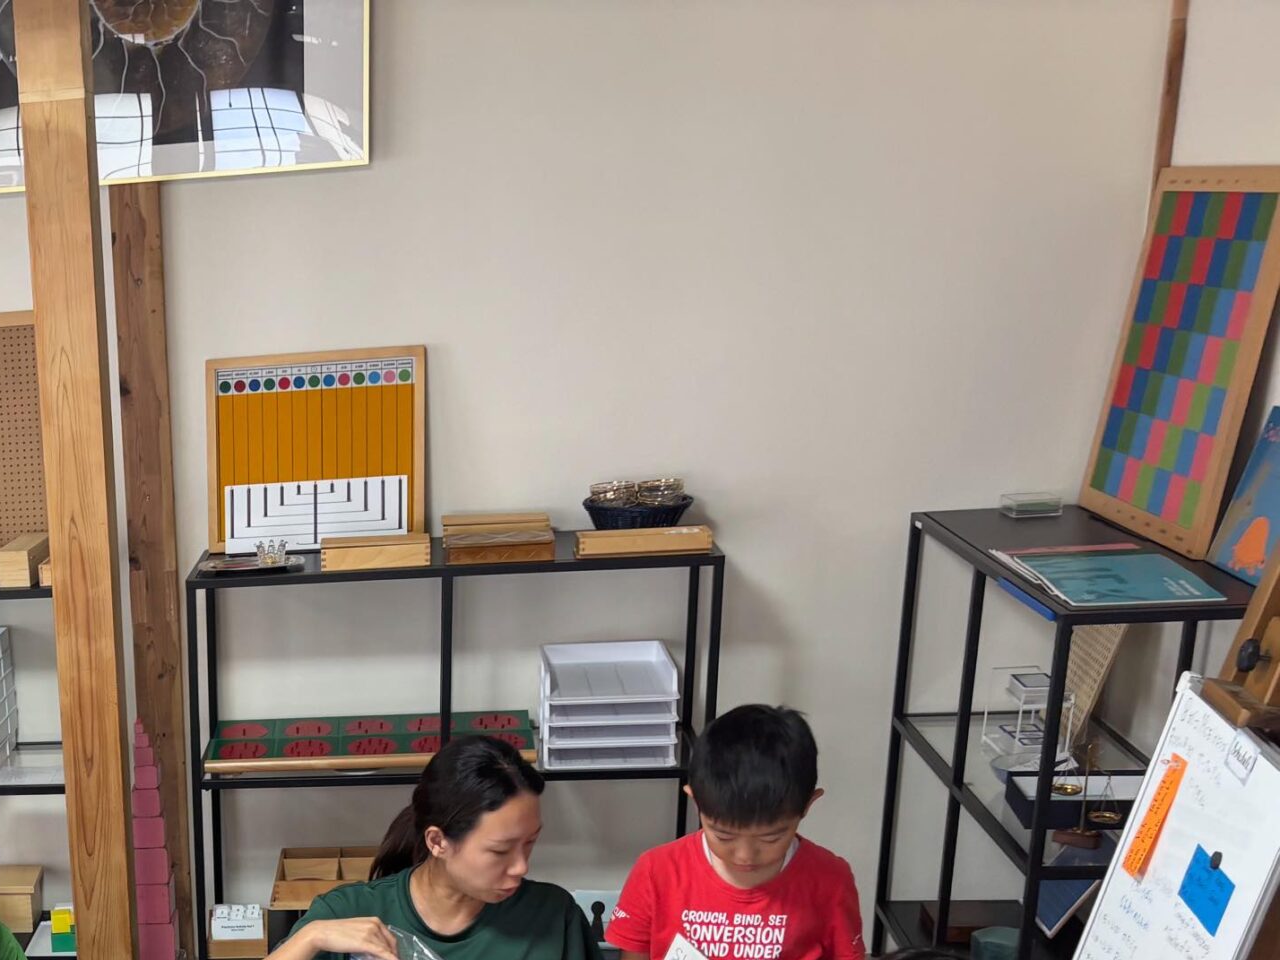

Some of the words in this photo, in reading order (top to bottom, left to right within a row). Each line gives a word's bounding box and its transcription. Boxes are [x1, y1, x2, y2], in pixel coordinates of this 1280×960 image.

[681, 909, 729, 925] CROUCH,
[733, 913, 764, 927] BIND,
[768, 914, 787, 926] SET
[733, 943, 782, 959] UNDER
